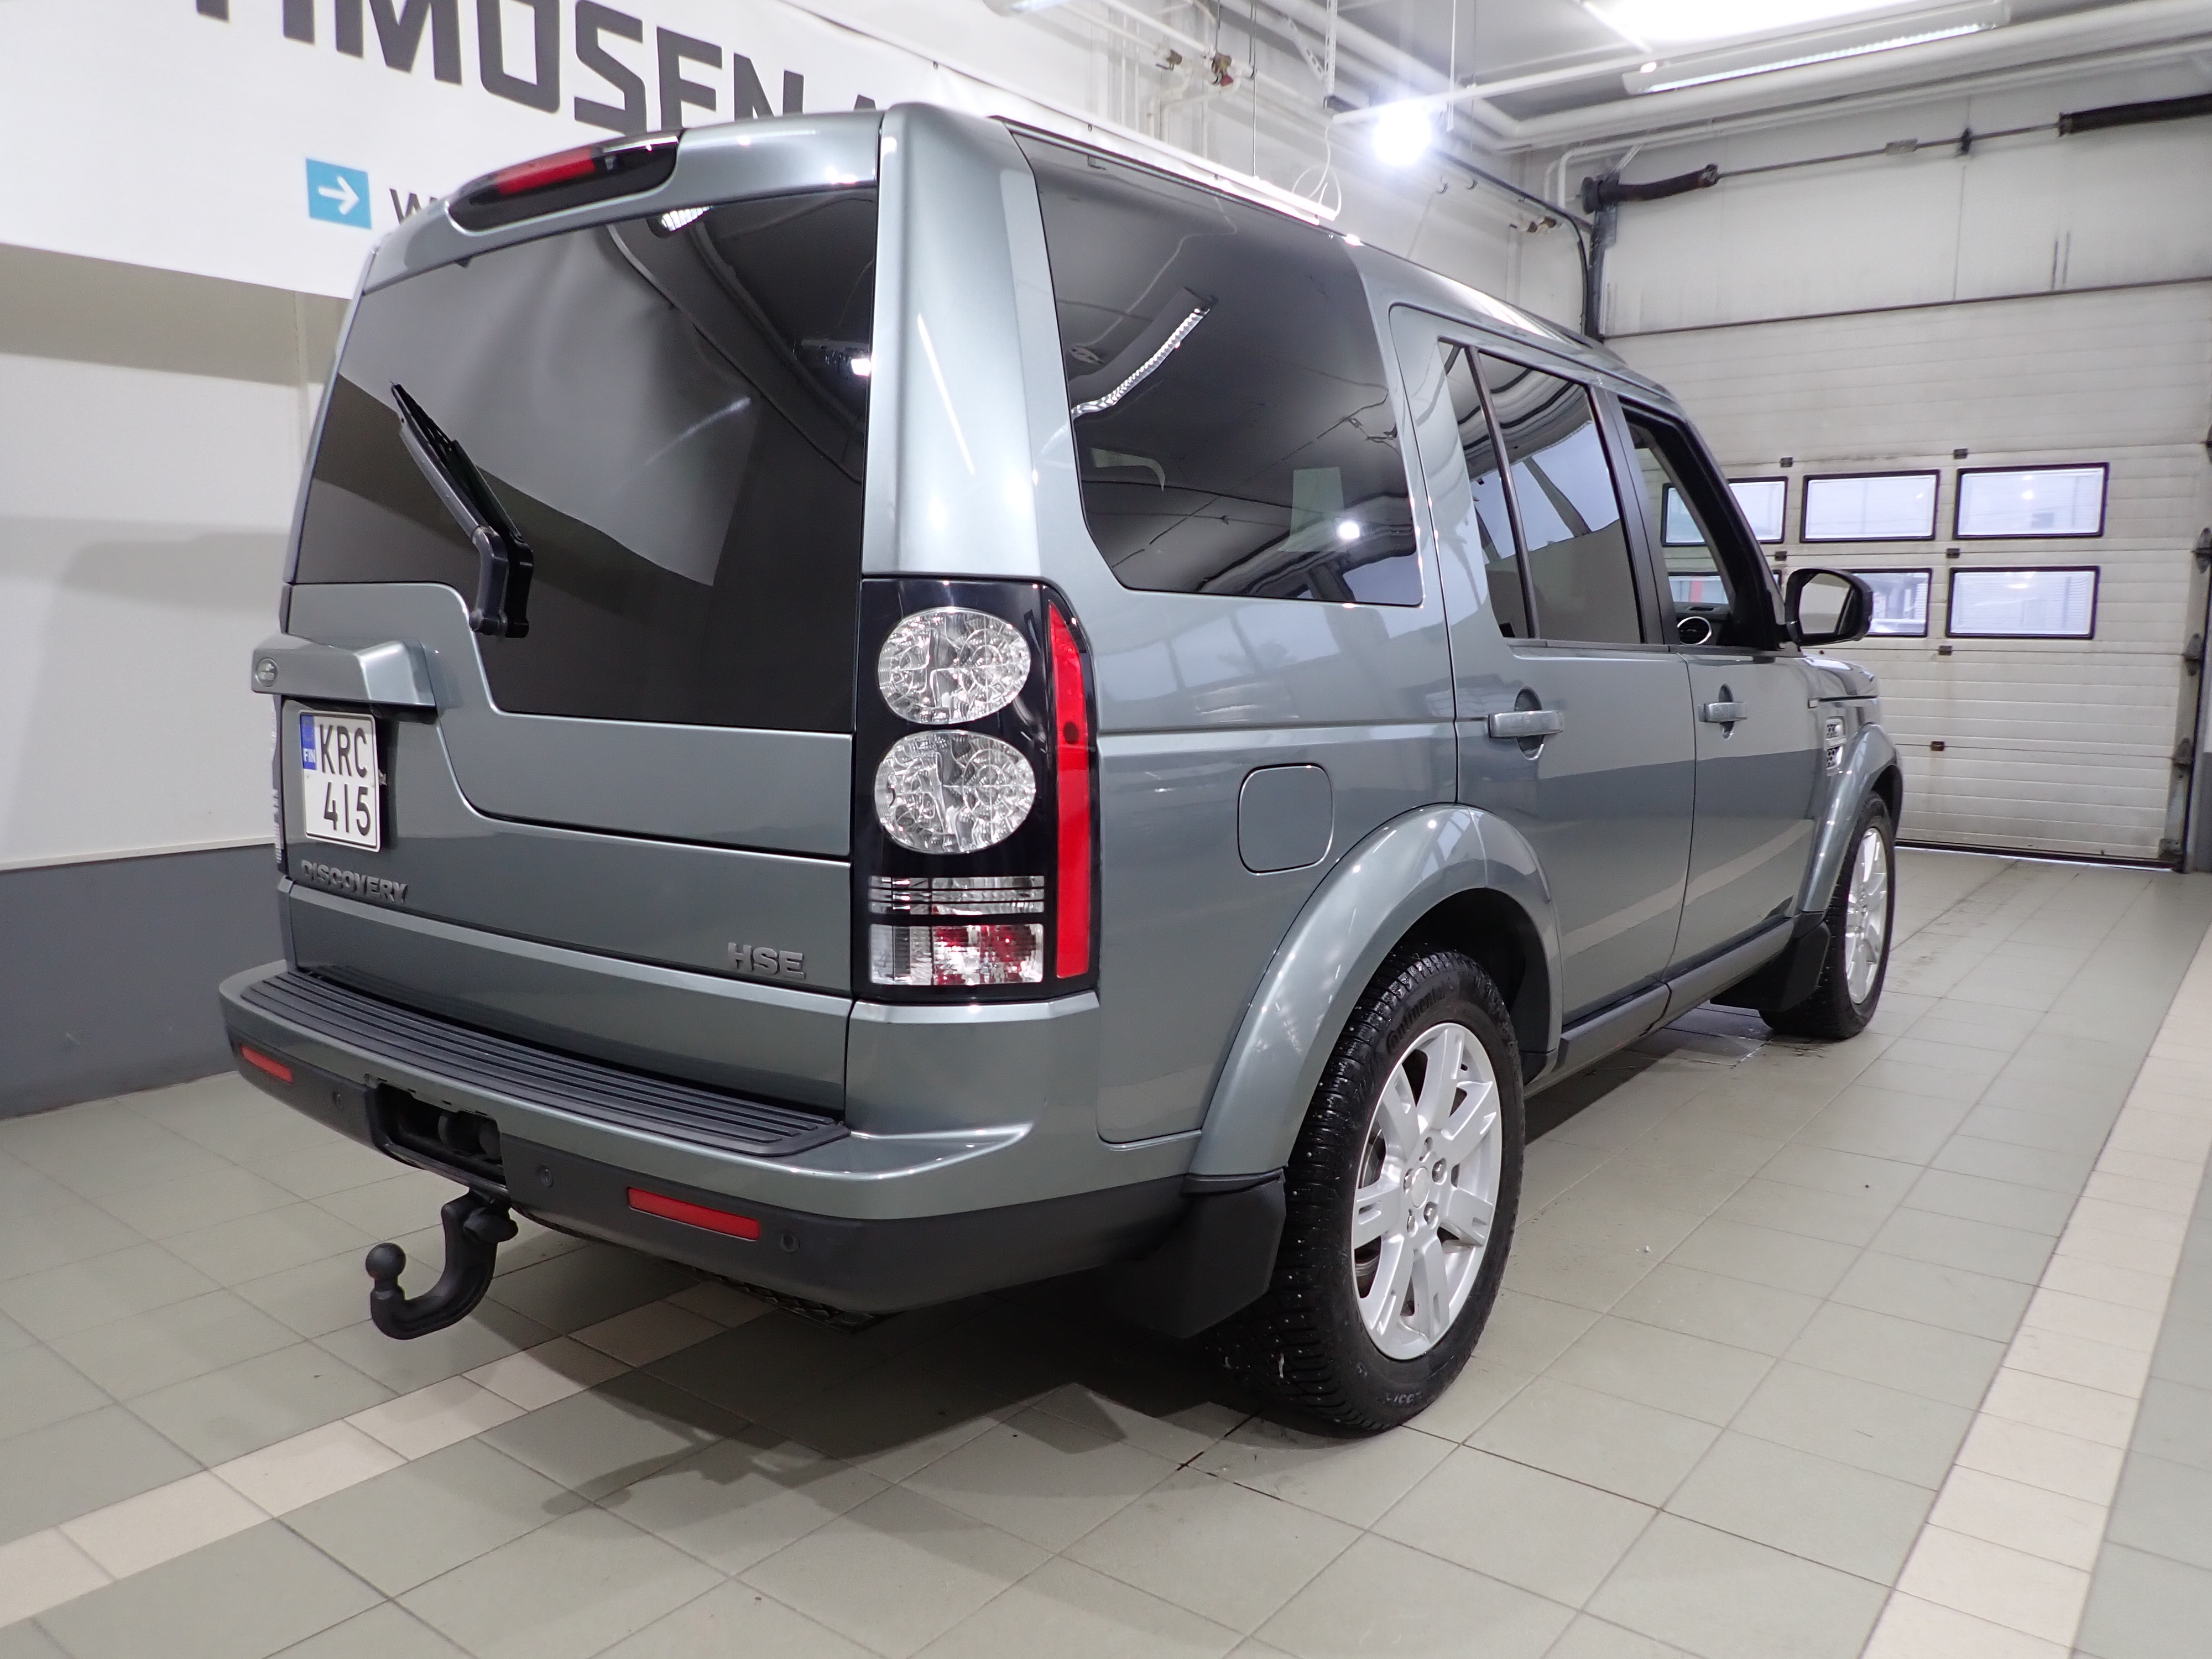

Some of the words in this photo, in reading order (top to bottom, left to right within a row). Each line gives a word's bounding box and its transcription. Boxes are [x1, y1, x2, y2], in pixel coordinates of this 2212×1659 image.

[303, 748, 316, 763] FIN
[319, 724, 368, 778] KRC
[324, 782, 371, 836] 415
[301, 860, 408, 902] DISCOVERY
[728, 942, 805, 979] HSE
